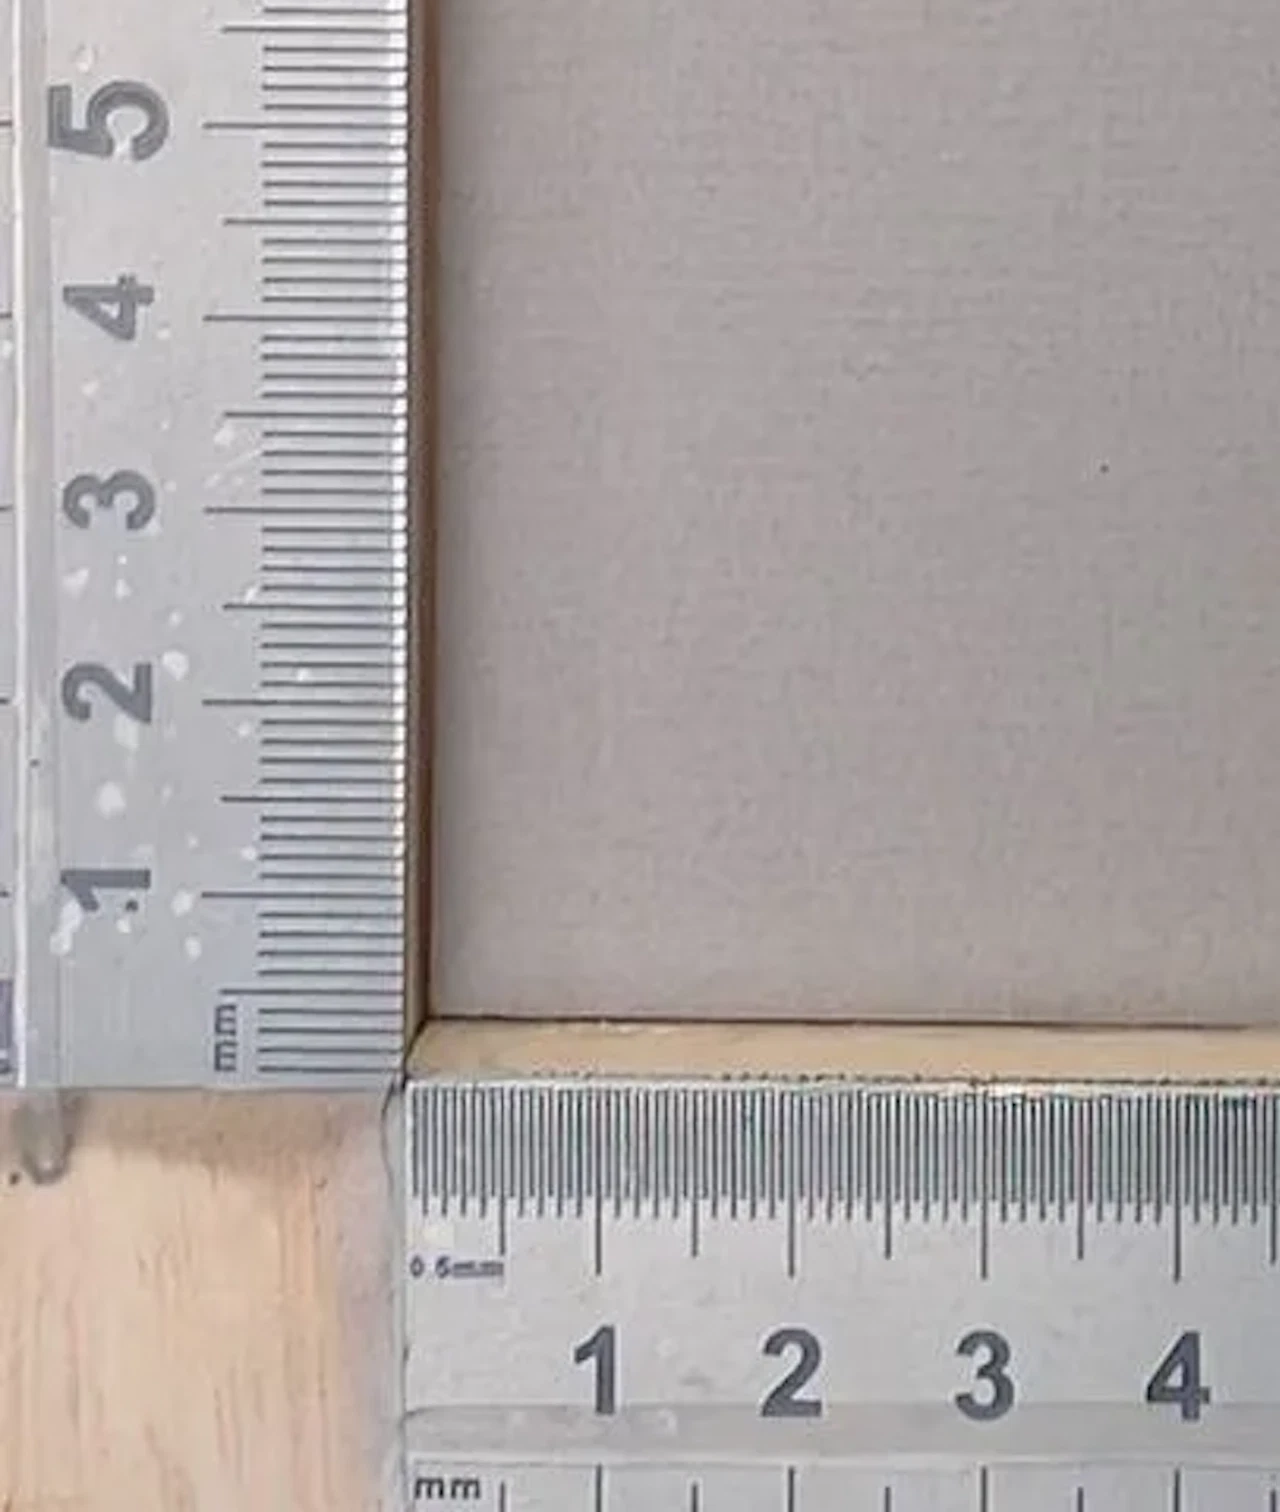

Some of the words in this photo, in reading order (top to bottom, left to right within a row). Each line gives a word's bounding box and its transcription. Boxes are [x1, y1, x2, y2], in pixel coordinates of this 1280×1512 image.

[47, 81, 169, 161] 5
[63, 275, 154, 341] 4
[62, 471, 155, 530] 3
[61, 662, 153, 725] 2
[59, 868, 151, 912] 1
[214, 1005, 237, 1072] mm
[574, 1325, 616, 1416] 1
[760, 1328, 822, 1418] 2
[955, 1330, 1014, 1421] 3
[1145, 1331, 1210, 1421] 4
[415, 1477, 480, 1499] mm
